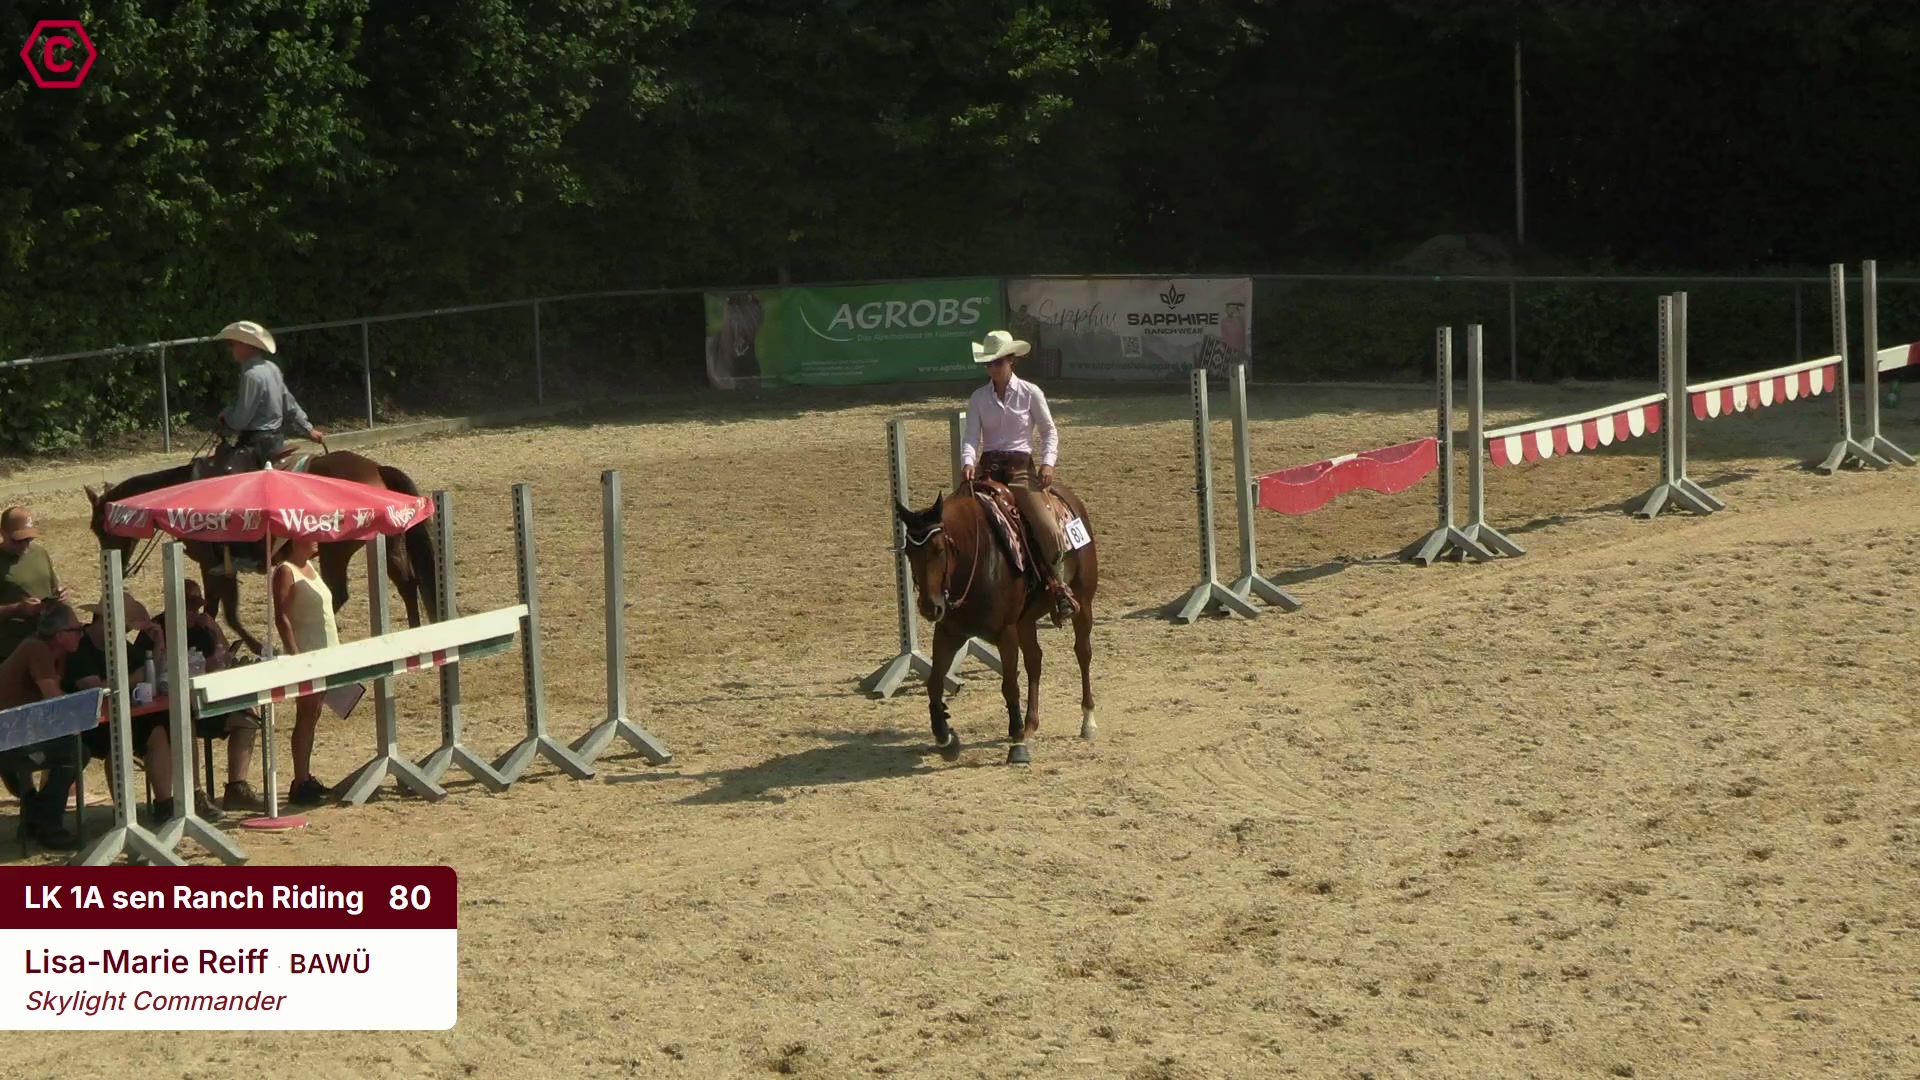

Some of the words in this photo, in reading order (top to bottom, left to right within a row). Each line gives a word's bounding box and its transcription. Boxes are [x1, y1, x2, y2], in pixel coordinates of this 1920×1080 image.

[1127, 313, 1219, 326] SAPPHIRE
[166, 507, 232, 531] West
[278, 508, 344, 532] West
